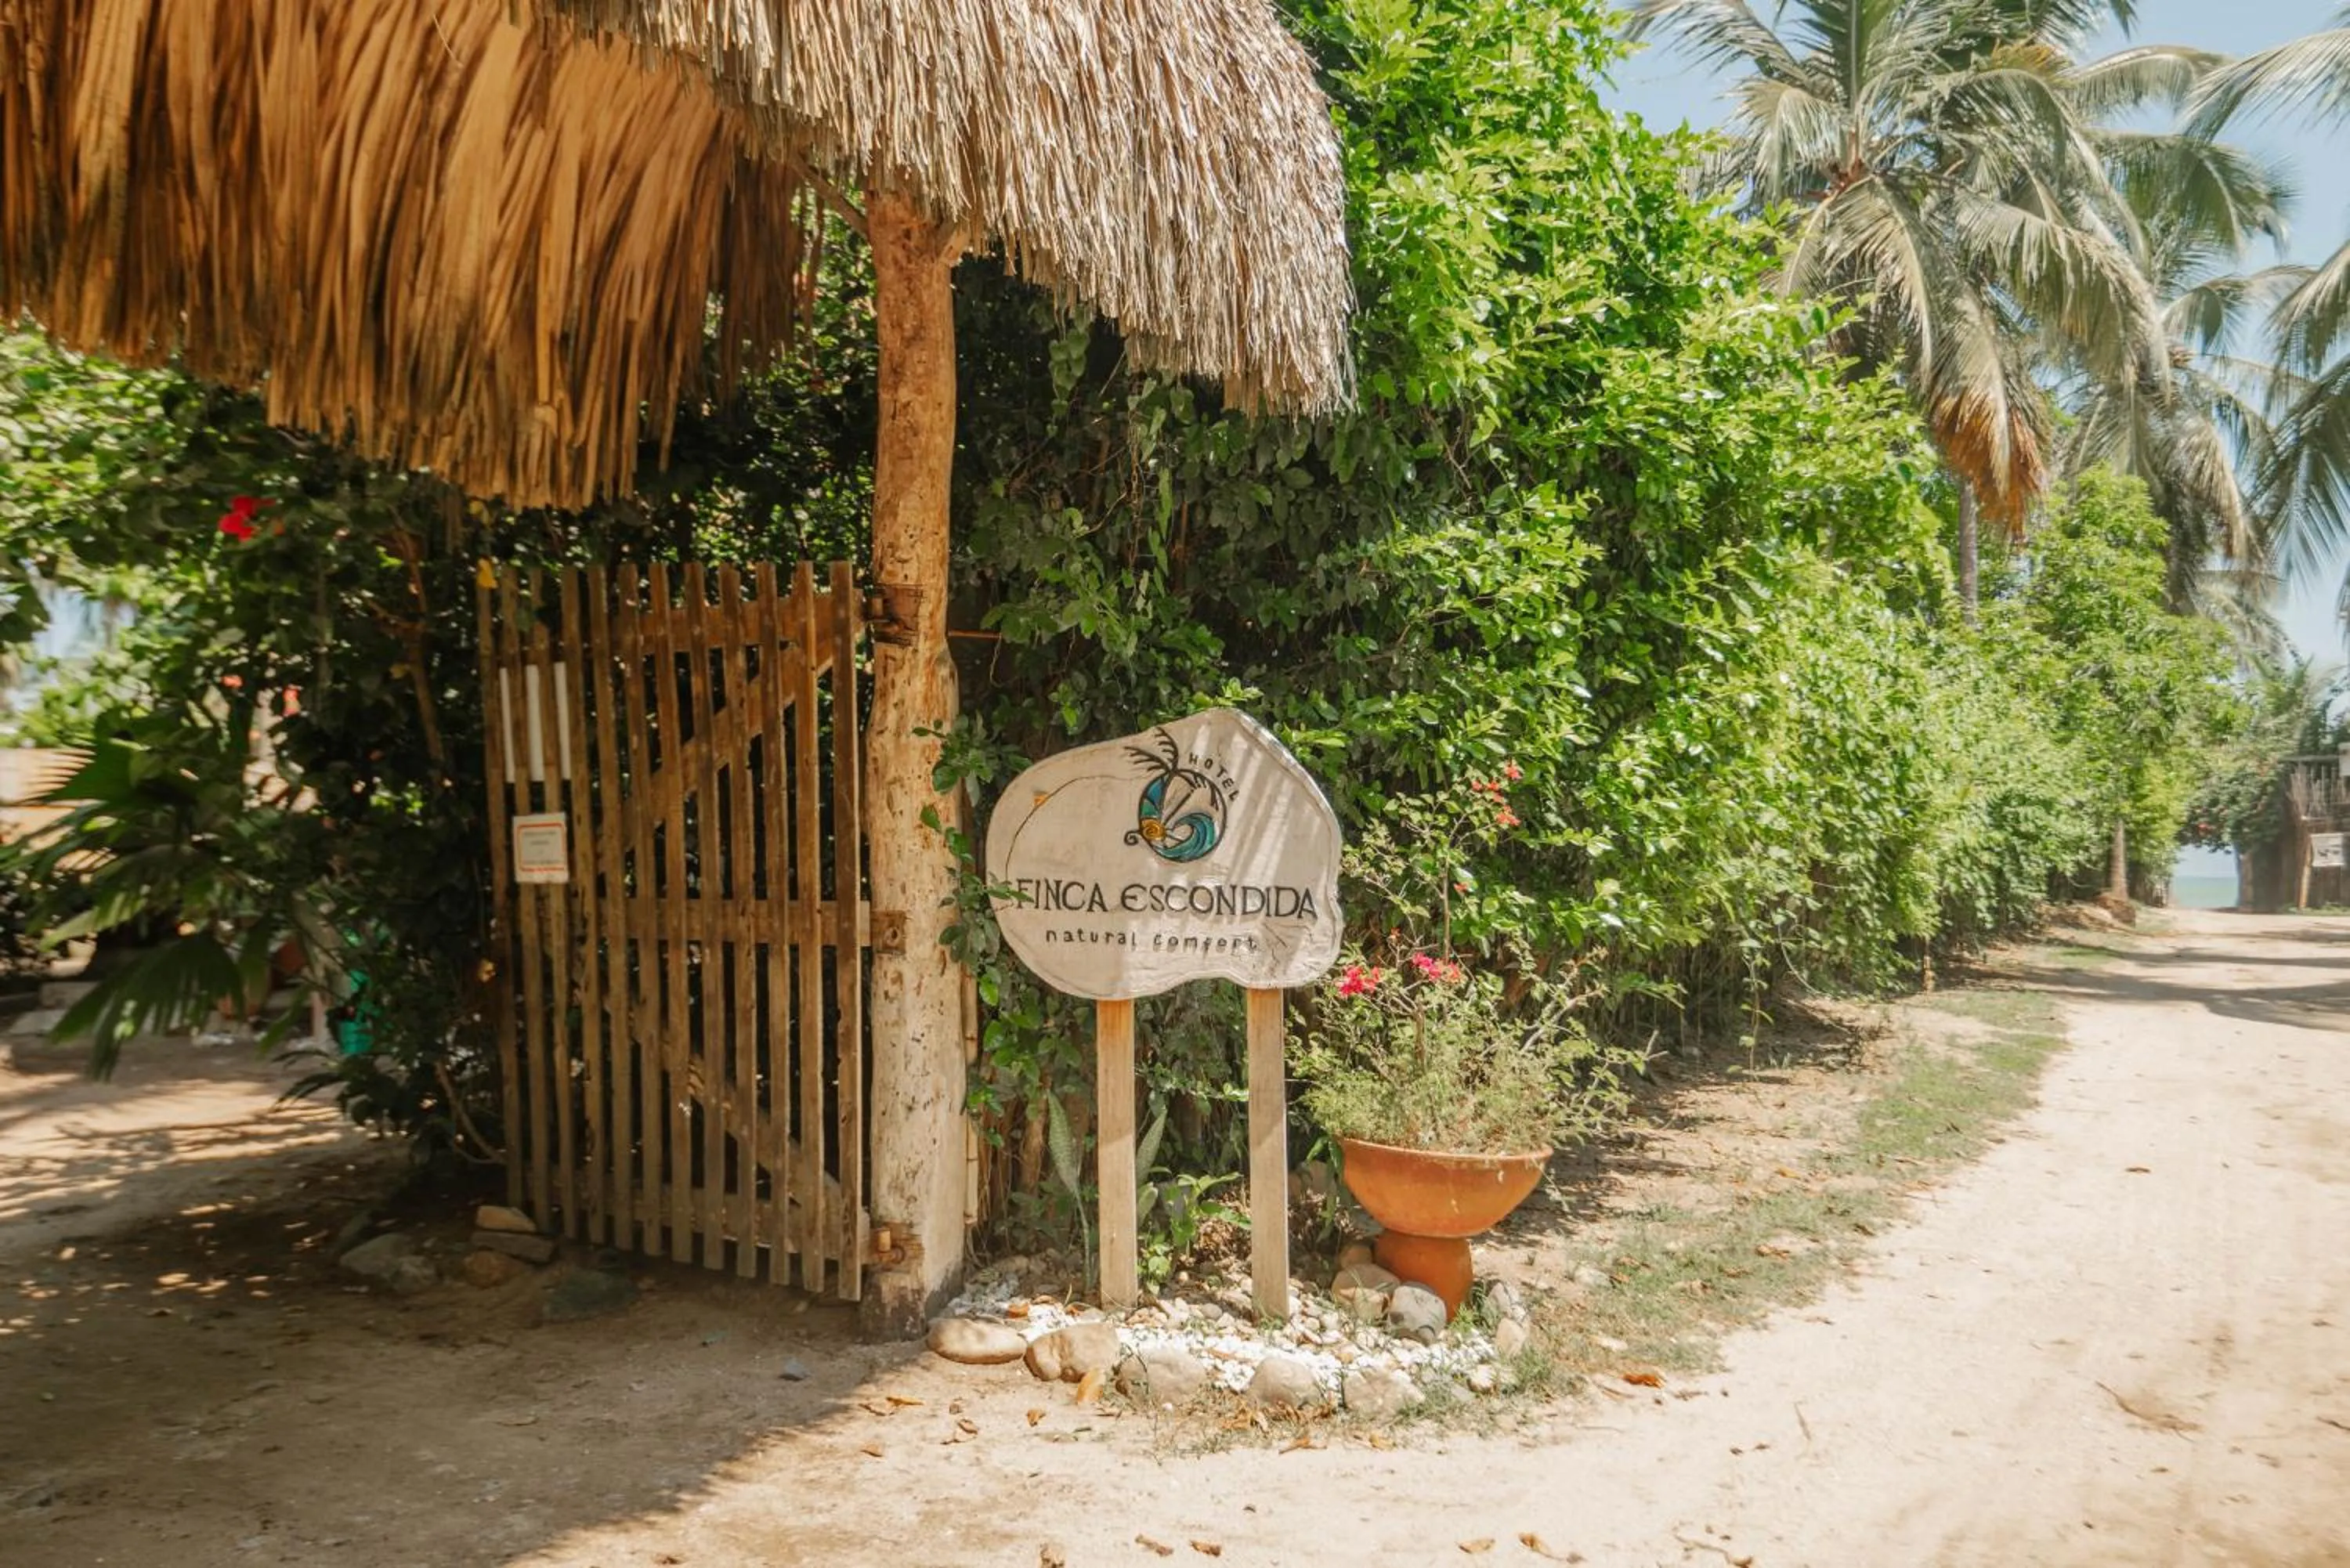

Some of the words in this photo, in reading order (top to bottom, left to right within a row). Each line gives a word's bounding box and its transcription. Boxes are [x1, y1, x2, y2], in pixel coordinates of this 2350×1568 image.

[1188, 752, 1240, 802] HOTEL
[1016, 876, 1108, 912] FINCA
[1120, 883, 1318, 920] ESCONDIDA
[1046, 927, 1137, 946] natural
[1153, 931, 1258, 954] comfort
